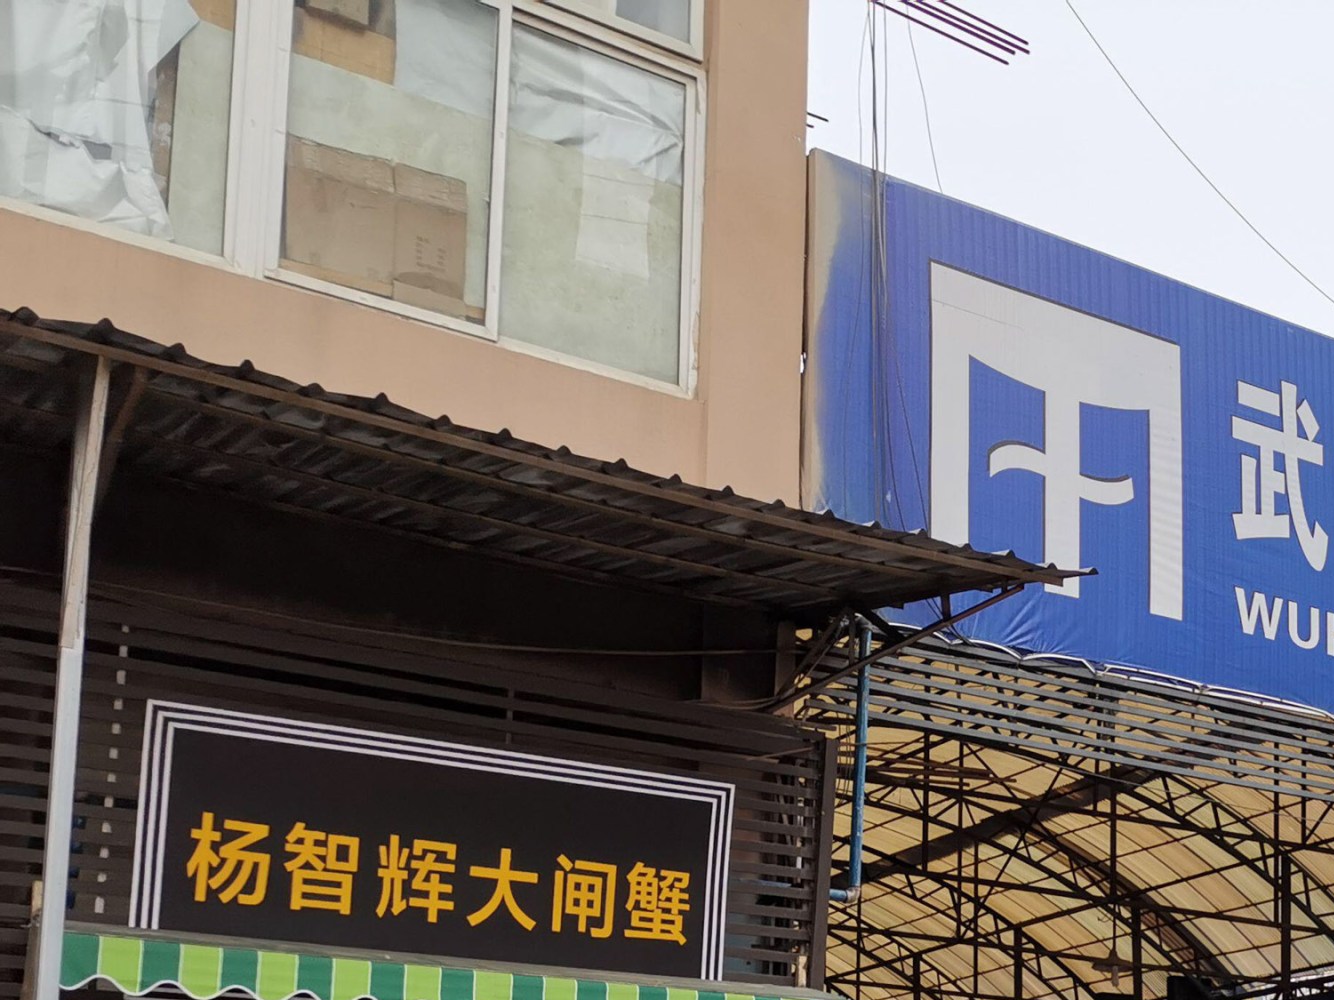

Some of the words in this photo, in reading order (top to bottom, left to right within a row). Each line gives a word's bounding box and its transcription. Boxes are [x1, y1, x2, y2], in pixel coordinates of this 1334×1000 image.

[185, 811, 691, 946] 杨智辉大闸蟹
